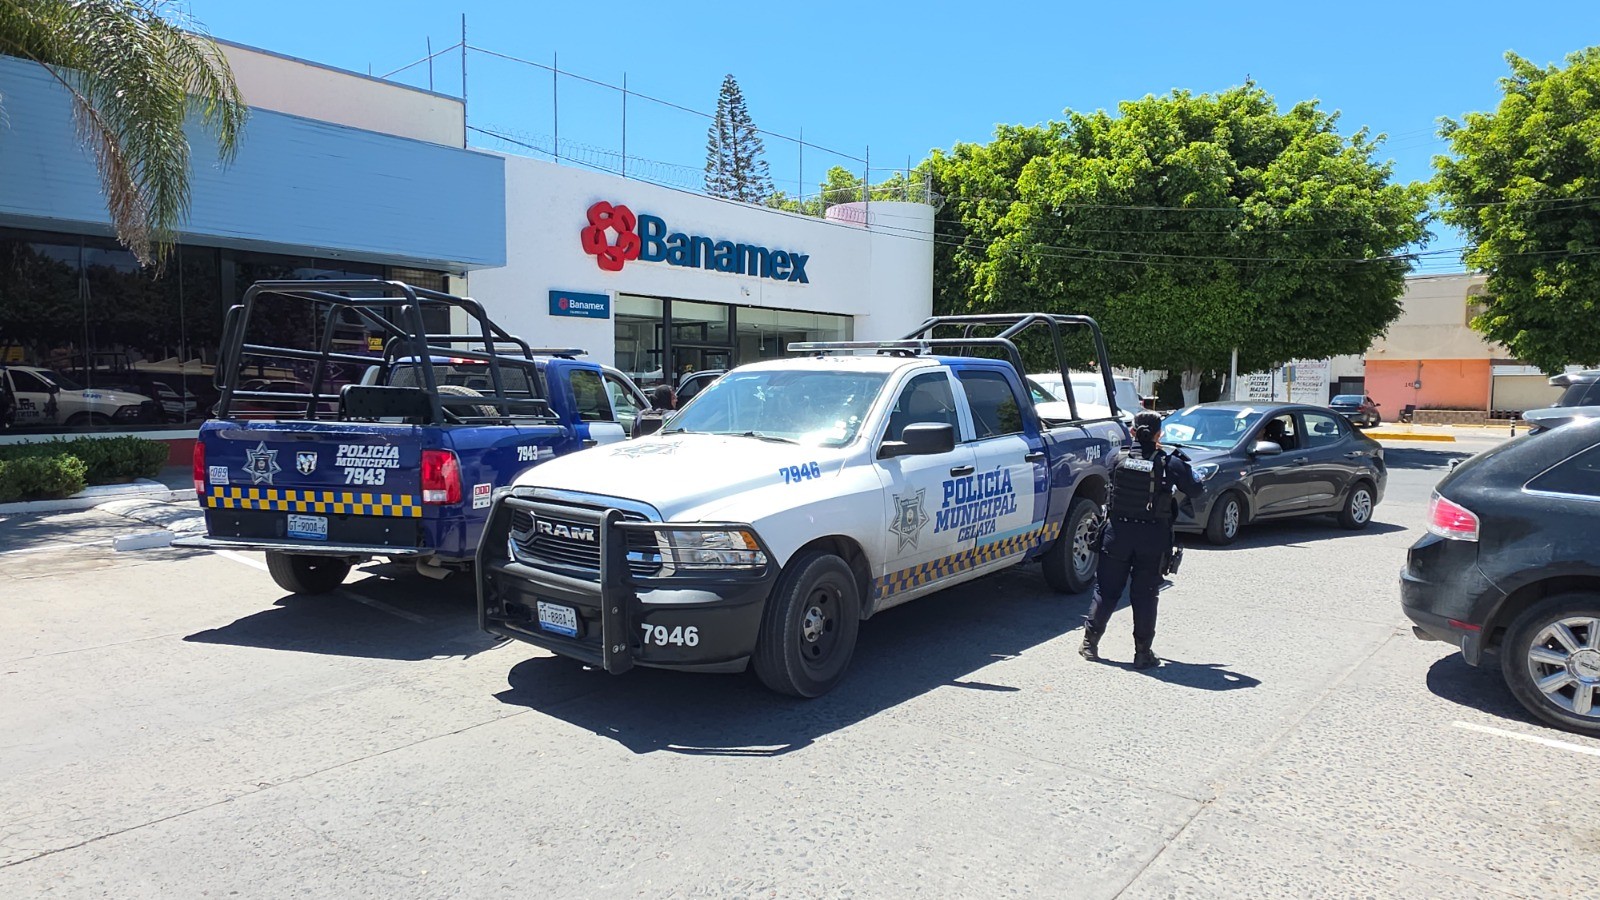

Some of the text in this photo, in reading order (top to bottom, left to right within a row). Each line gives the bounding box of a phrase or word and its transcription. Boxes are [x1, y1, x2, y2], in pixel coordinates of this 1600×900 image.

[637, 213, 810, 284] Banamex
[569, 299, 605, 311] Banamex
[336, 443, 400, 459] POLICÍA
[517, 445, 538, 462] 7943
[1085, 444, 1101, 461] 7946
[335, 457, 400, 469] MUNICIPAL
[778, 461, 821, 485] 7946
[344, 467, 386, 486] 7943
[942, 465, 1013, 508] POLICÍA
[475, 486, 490, 496] 911
[934, 493, 1017, 533] MUNICIPAL
[536, 520, 595, 542] RAM
[957, 519, 996, 543] CELAYA
[641, 623, 699, 647] 7946
